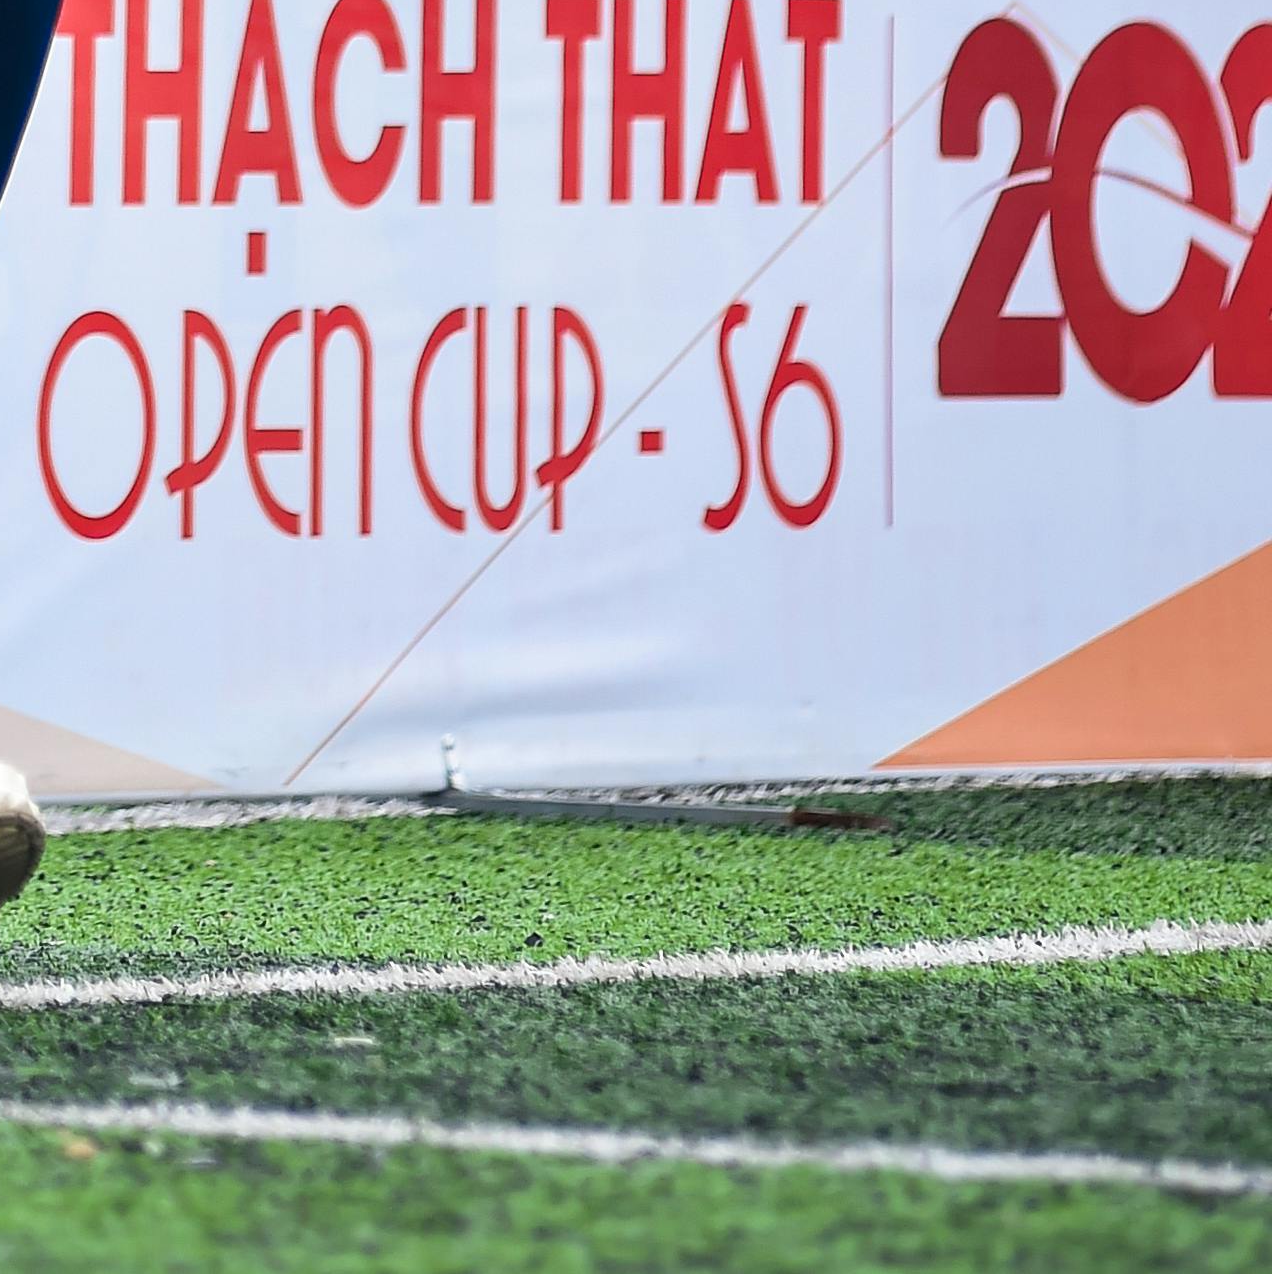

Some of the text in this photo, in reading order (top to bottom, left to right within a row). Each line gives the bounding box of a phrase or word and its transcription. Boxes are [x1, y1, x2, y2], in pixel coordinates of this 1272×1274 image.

[38, 305, 372, 540] OPEN
[411, 306, 603, 532] CUP
[702, 303, 840, 532] S6
